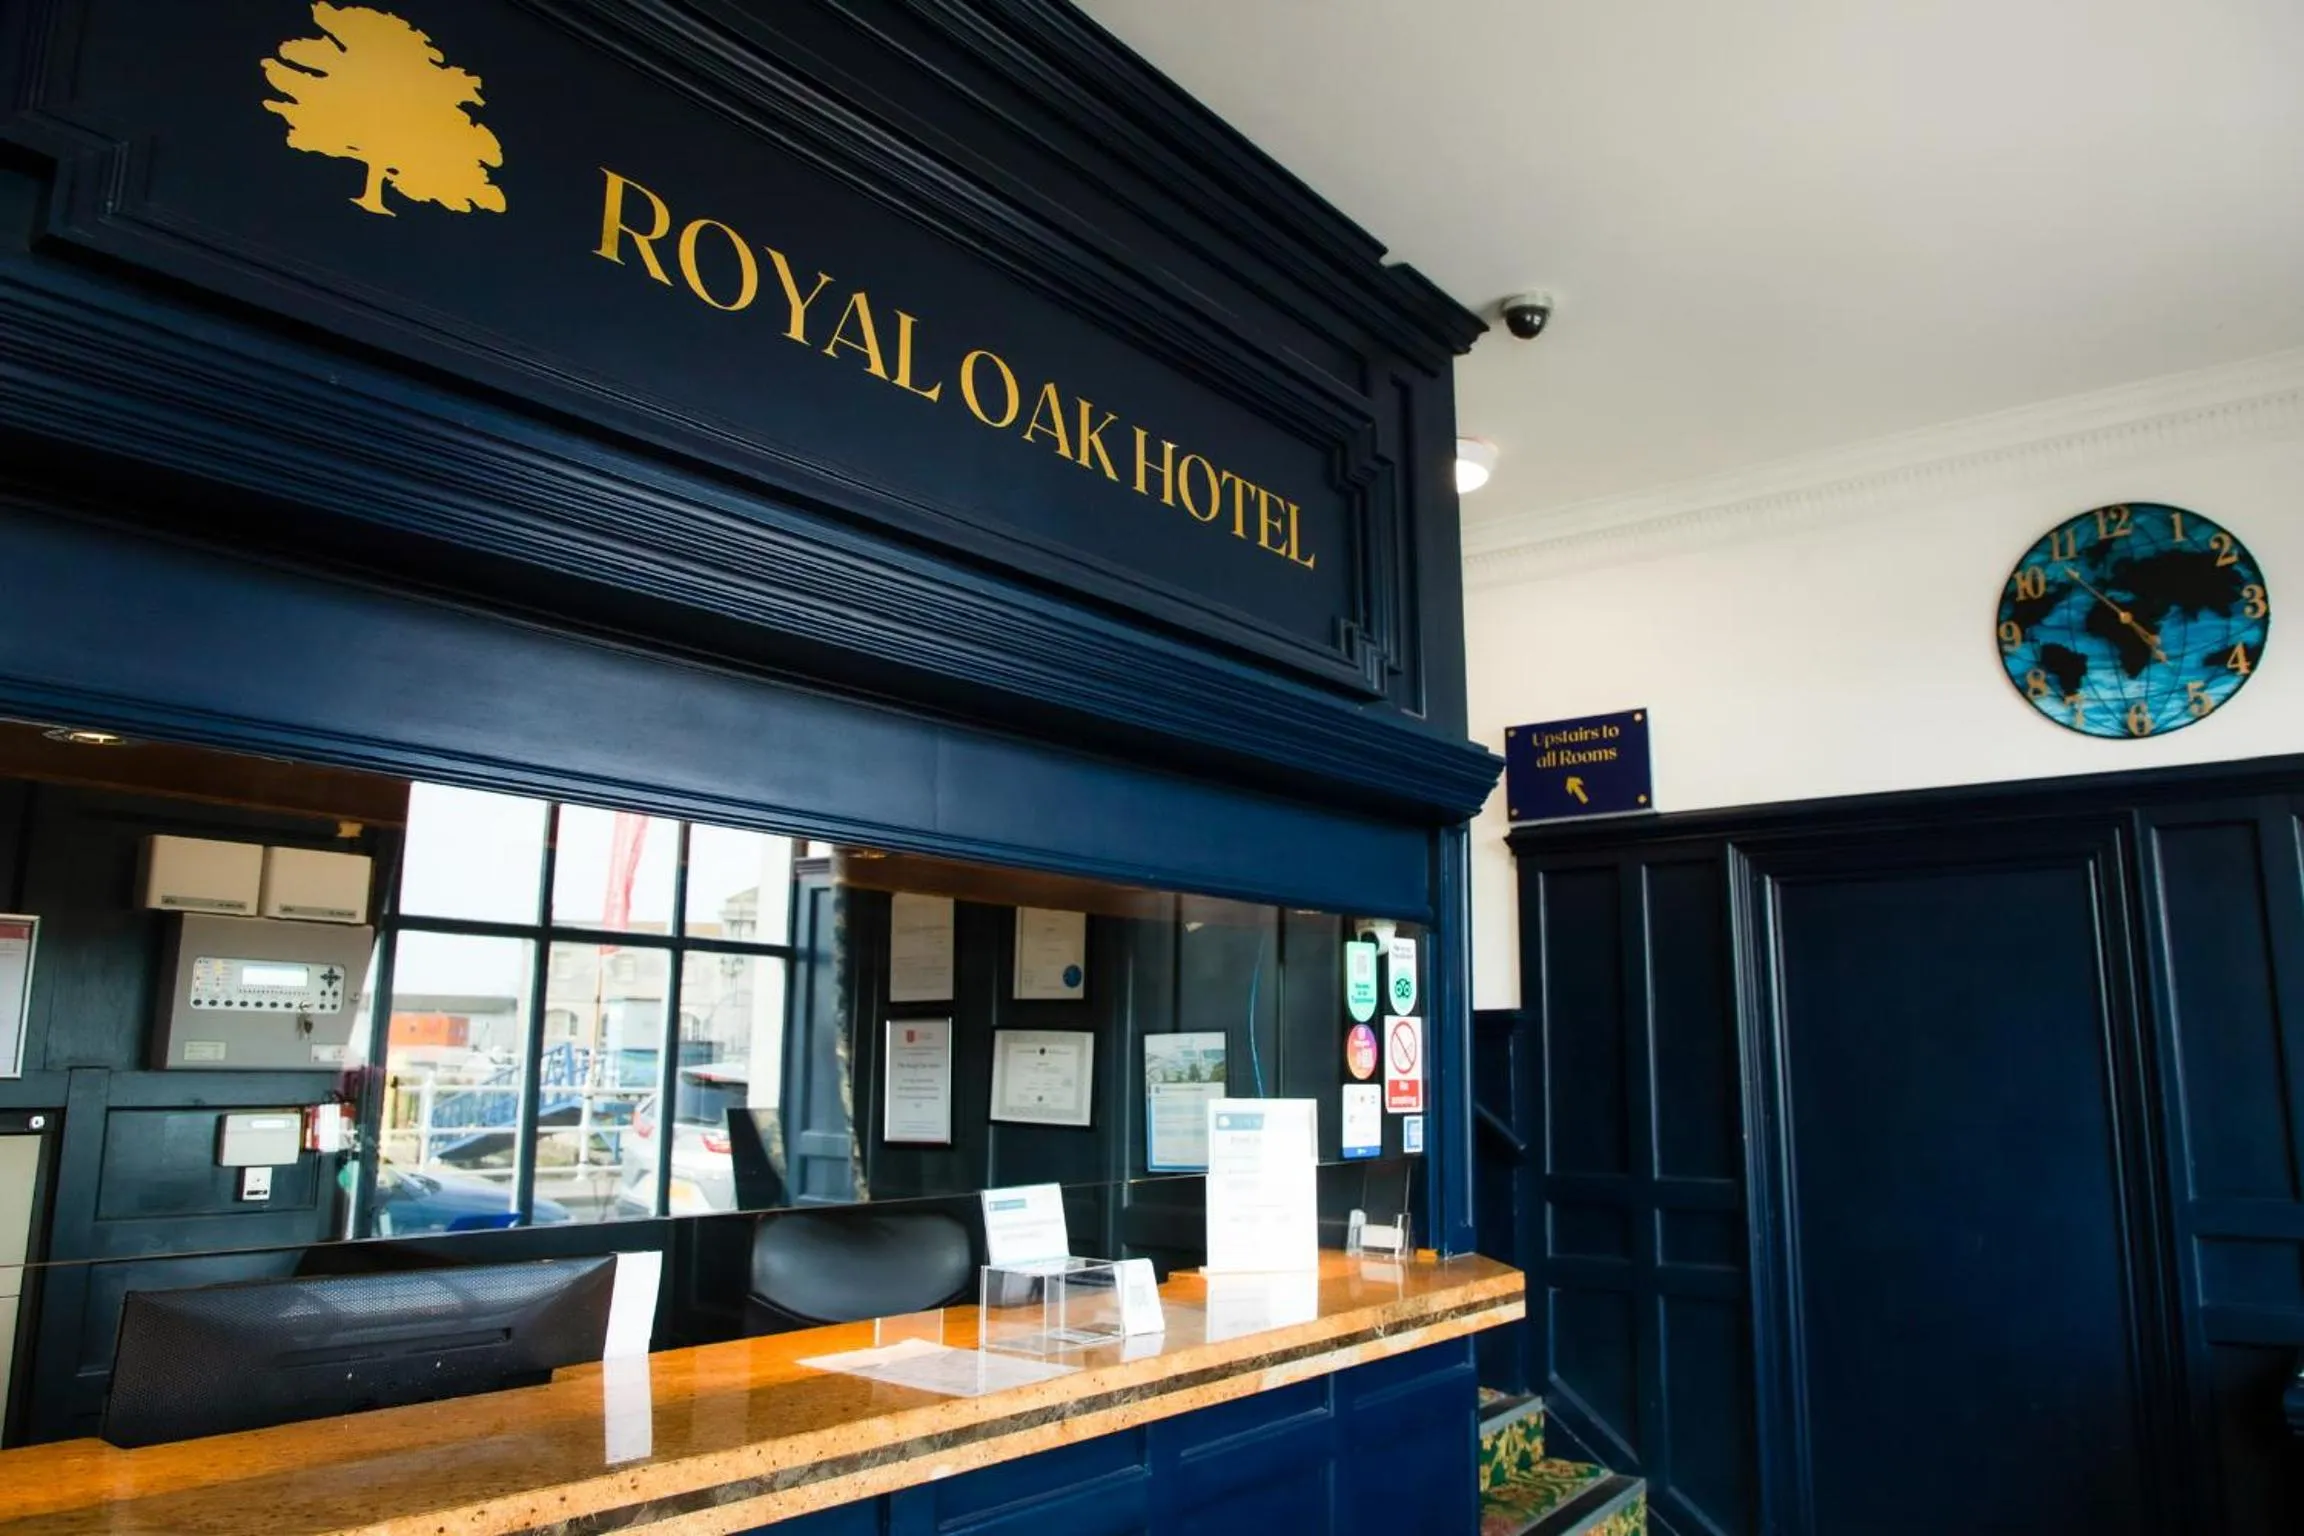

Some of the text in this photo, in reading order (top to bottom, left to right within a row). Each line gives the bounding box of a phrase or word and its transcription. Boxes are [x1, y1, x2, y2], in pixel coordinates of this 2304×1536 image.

[591, 166, 1316, 570] ROYAL OAK HOTEL
[2095, 504, 2133, 540] 12
[2170, 512, 2187, 542] 1
[2049, 528, 2078, 561] 11
[2210, 532, 2239, 567] 2
[2013, 566, 2046, 601] 10
[2241, 584, 2267, 619] 3
[1999, 620, 2022, 652] 9
[2226, 642, 2251, 675] 4
[2026, 668, 2047, 699] 8
[2187, 681, 2213, 717] 5
[2063, 693, 2085, 728] 7
[2127, 702, 2155, 736] 6
[1533, 725, 1619, 749] Upstairs to
[1536, 747, 1617, 768] all Rooms
